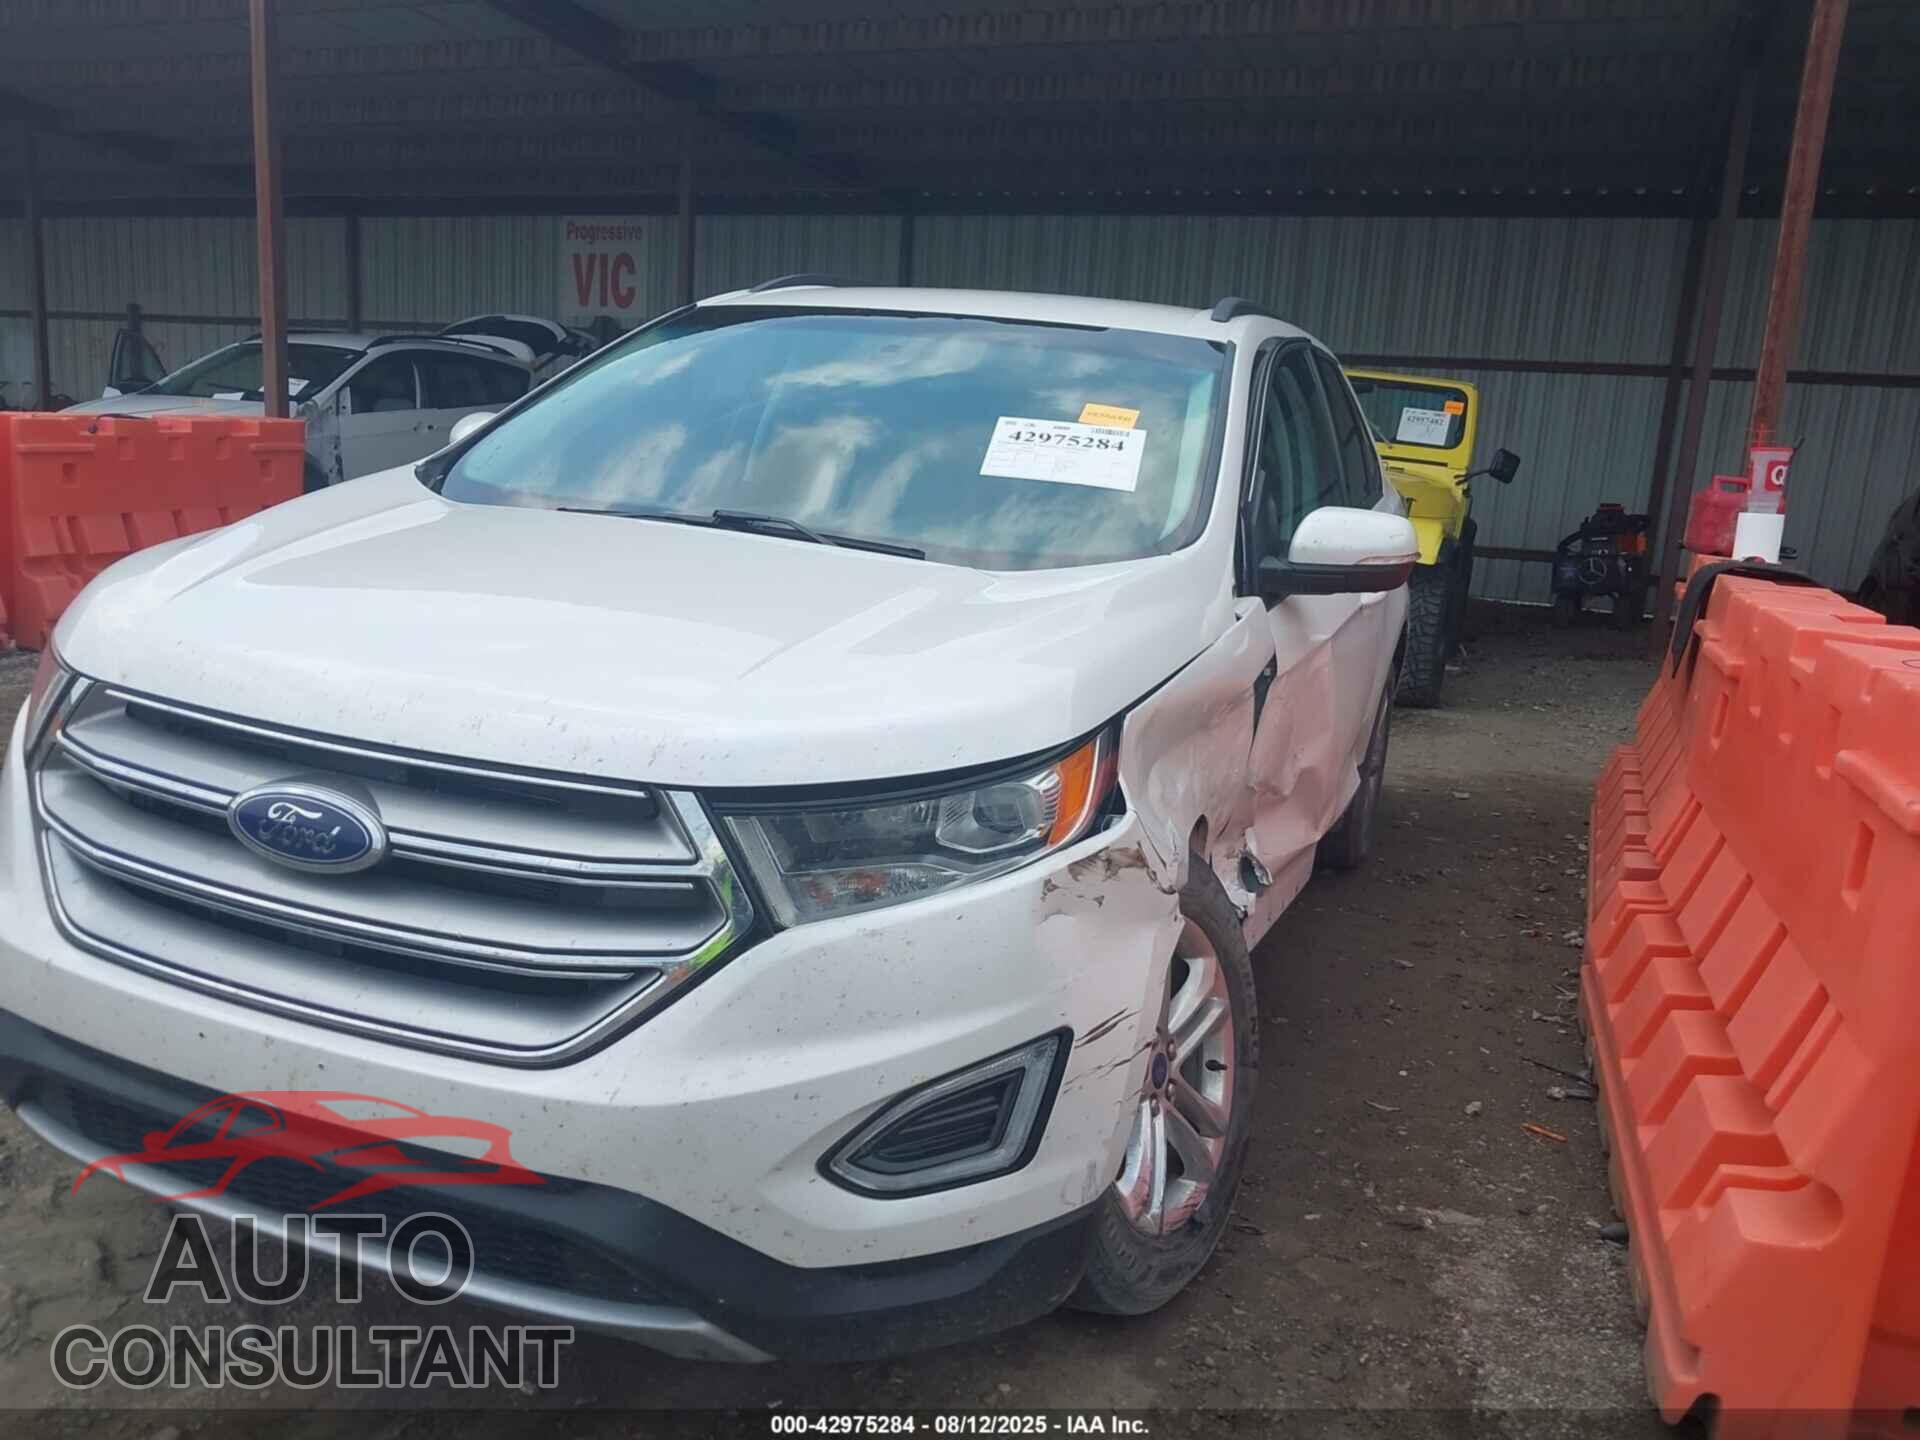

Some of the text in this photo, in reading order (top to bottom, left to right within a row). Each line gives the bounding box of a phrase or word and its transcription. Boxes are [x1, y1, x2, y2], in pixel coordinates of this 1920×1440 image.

[566, 220, 642, 245] Progressive
[572, 252, 638, 308] VIC
[1008, 430, 1125, 452] 42975284
[258, 802, 342, 854] Ford
